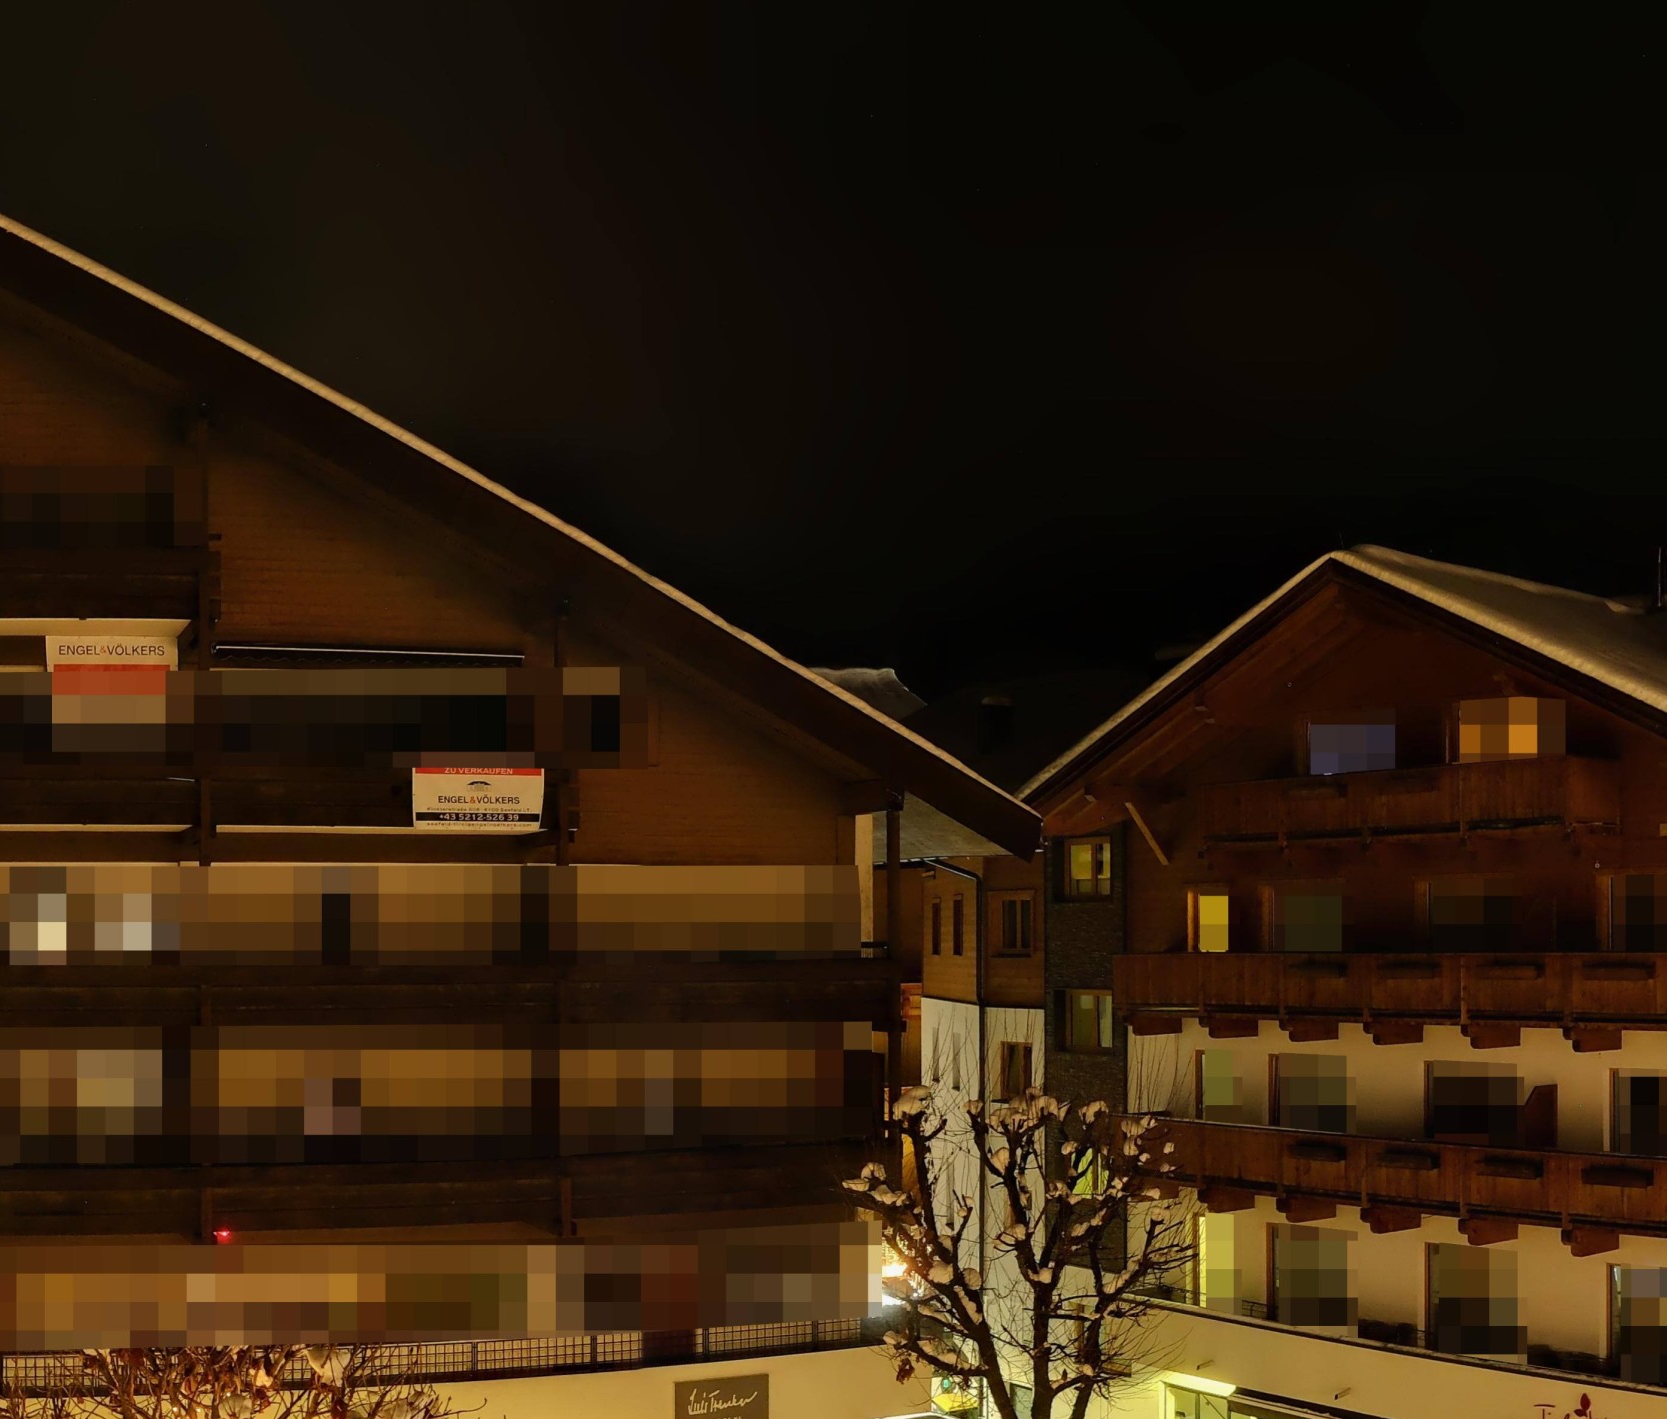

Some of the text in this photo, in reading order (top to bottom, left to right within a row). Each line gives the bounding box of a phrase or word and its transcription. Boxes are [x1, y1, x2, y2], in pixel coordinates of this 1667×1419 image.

[58, 643, 166, 657] ENGEL&VÖLKERS
[459, 767, 514, 775] VERKAUFEN
[437, 794, 521, 805] ENGEL&VÖLKERS
[458, 813, 506, 822] 5212-526
[507, 814, 520, 822] 39
